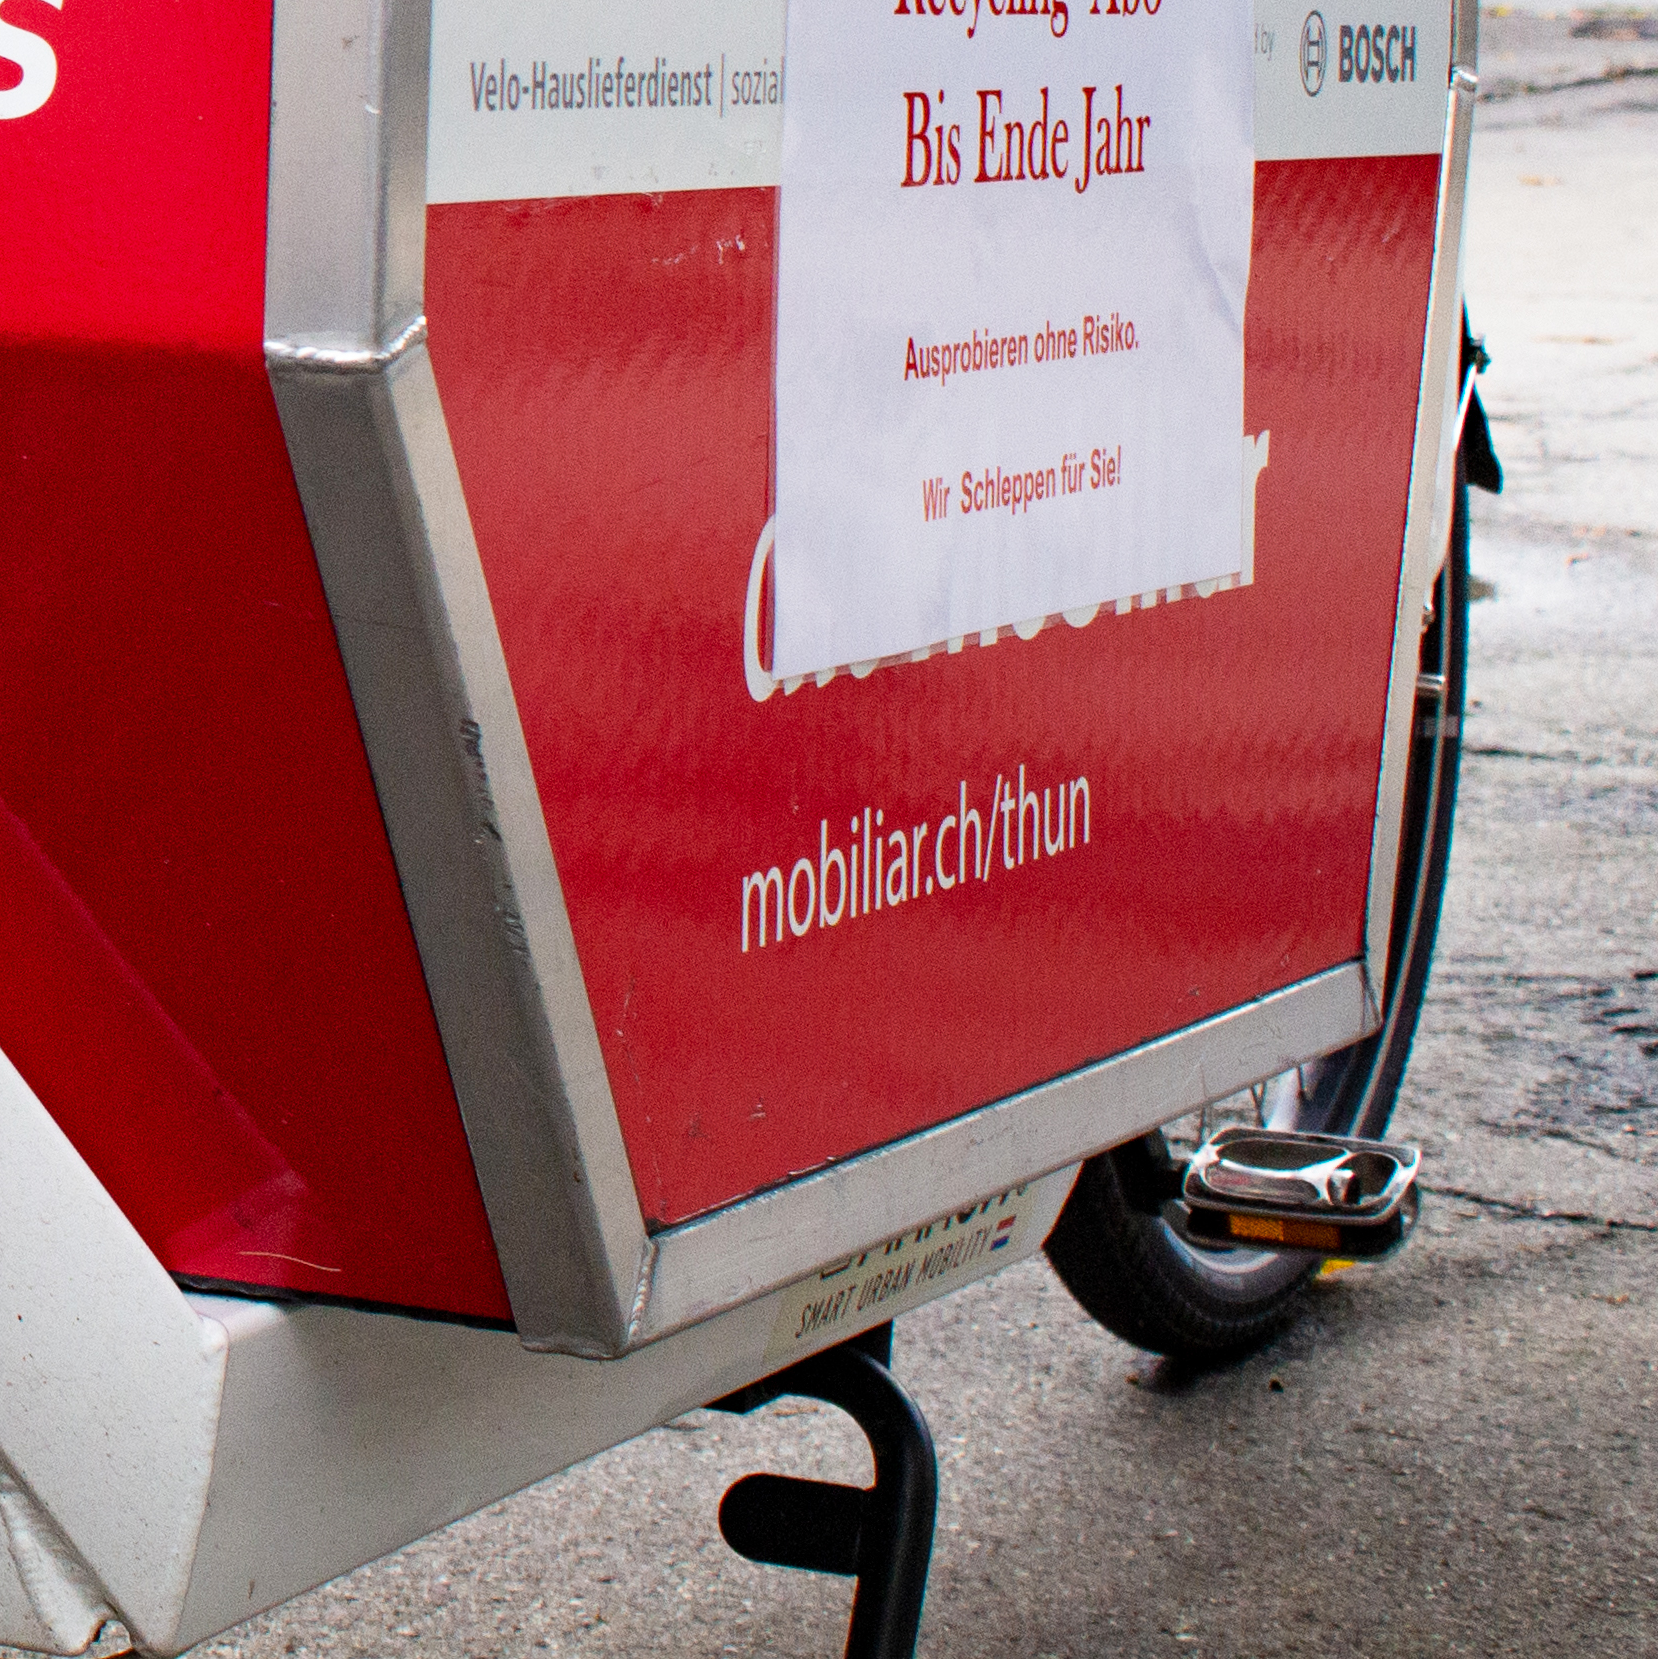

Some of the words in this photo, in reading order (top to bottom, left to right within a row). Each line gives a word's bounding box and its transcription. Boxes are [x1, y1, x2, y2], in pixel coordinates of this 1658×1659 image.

[470, 56, 712, 111] Velo-Hauslieferdienst
[1338, 24, 1416, 83] BOSCH
[900, 89, 961, 188] Bis
[973, 86, 1069, 184] Ende
[1074, 84, 1151, 194] Jahr
[904, 327, 1028, 387] Ausprobieren
[1034, 320, 1077, 363] ohne
[1082, 312, 1139, 356] Risiko.
[922, 477, 950, 522] Wir
[960, 465, 1056, 515] Schleppen
[1060, 452, 1085, 495] für
[1090, 444, 1121, 490] Sie!
[741, 763, 1090, 953] mobiliar.ch/thun
[795, 1284, 856, 1338] SMART
[856, 1259, 916, 1311] URBAN
